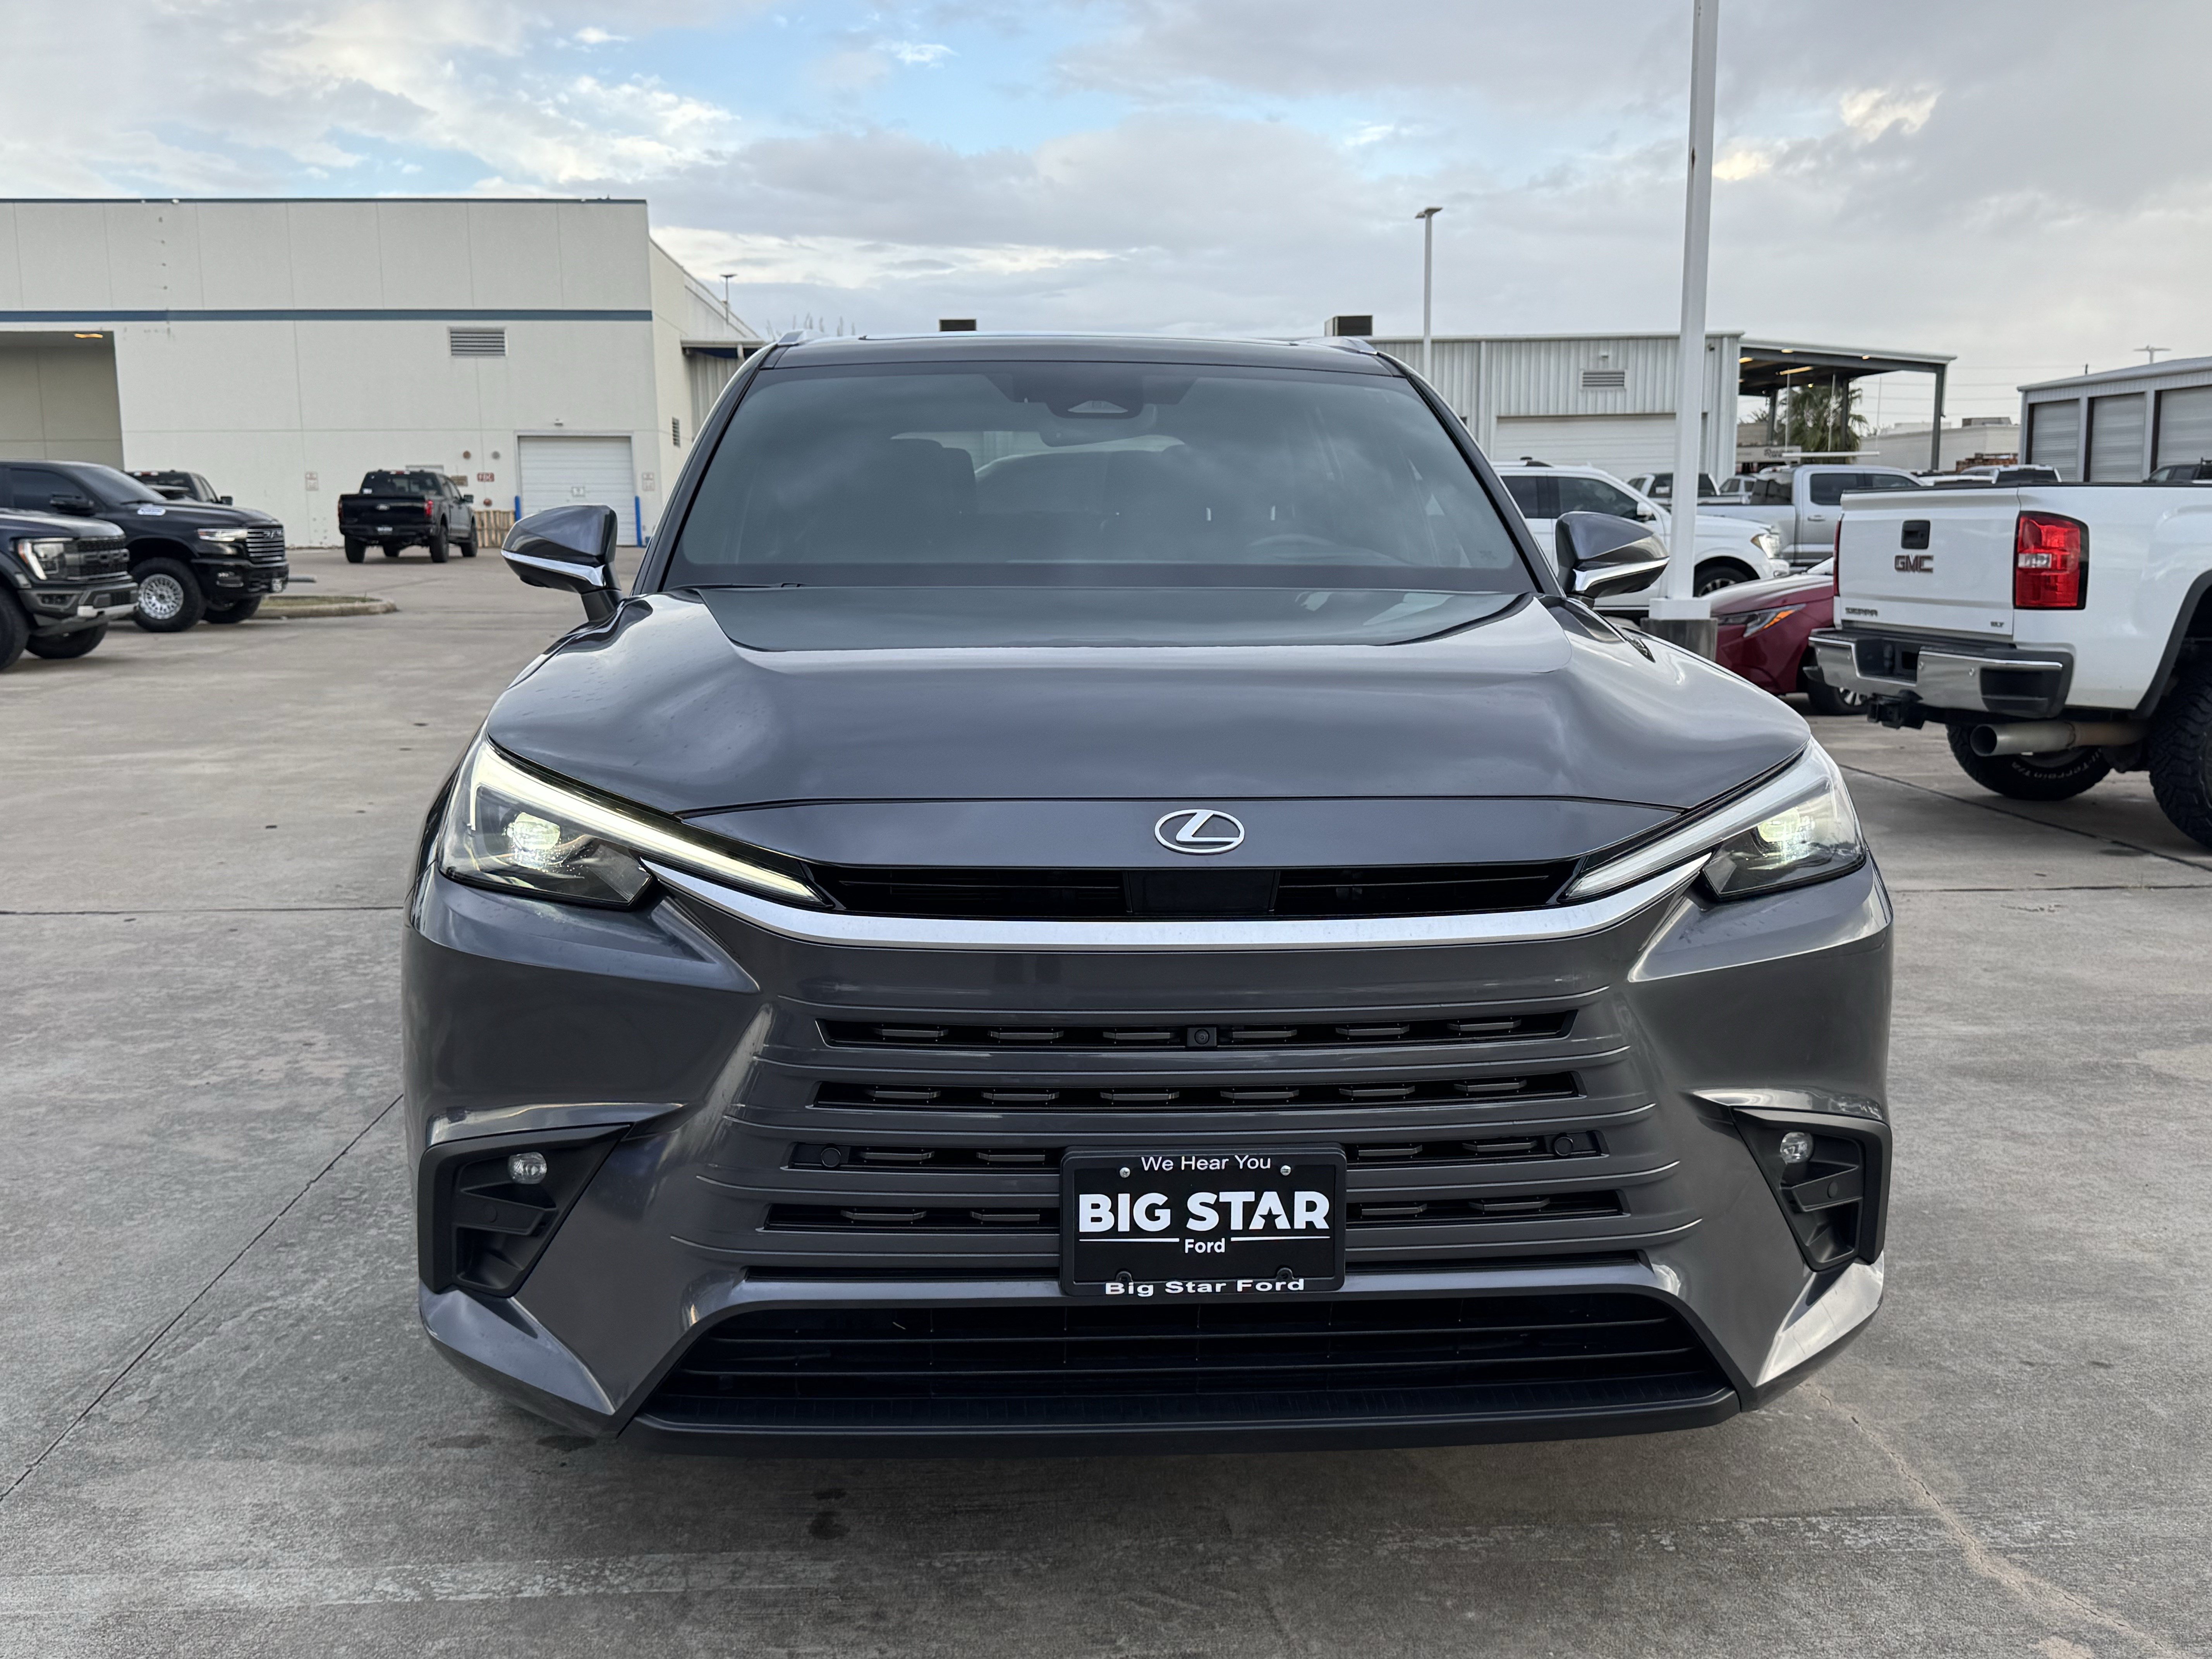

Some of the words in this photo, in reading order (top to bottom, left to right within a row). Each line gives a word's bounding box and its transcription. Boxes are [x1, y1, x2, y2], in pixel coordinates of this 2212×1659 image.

[1894, 555, 1934, 573] GMC
[1141, 1156, 1174, 1171] We
[1181, 1156, 1229, 1171] Hear
[1234, 1154, 1271, 1170] You
[1079, 1193, 1171, 1232] BIG
[1187, 1191, 1329, 1231] STAR
[1185, 1238, 1225, 1254] Ford
[1106, 1282, 1154, 1297] Big
[1165, 1281, 1227, 1294] Star
[1237, 1278, 1304, 1292] Ford
